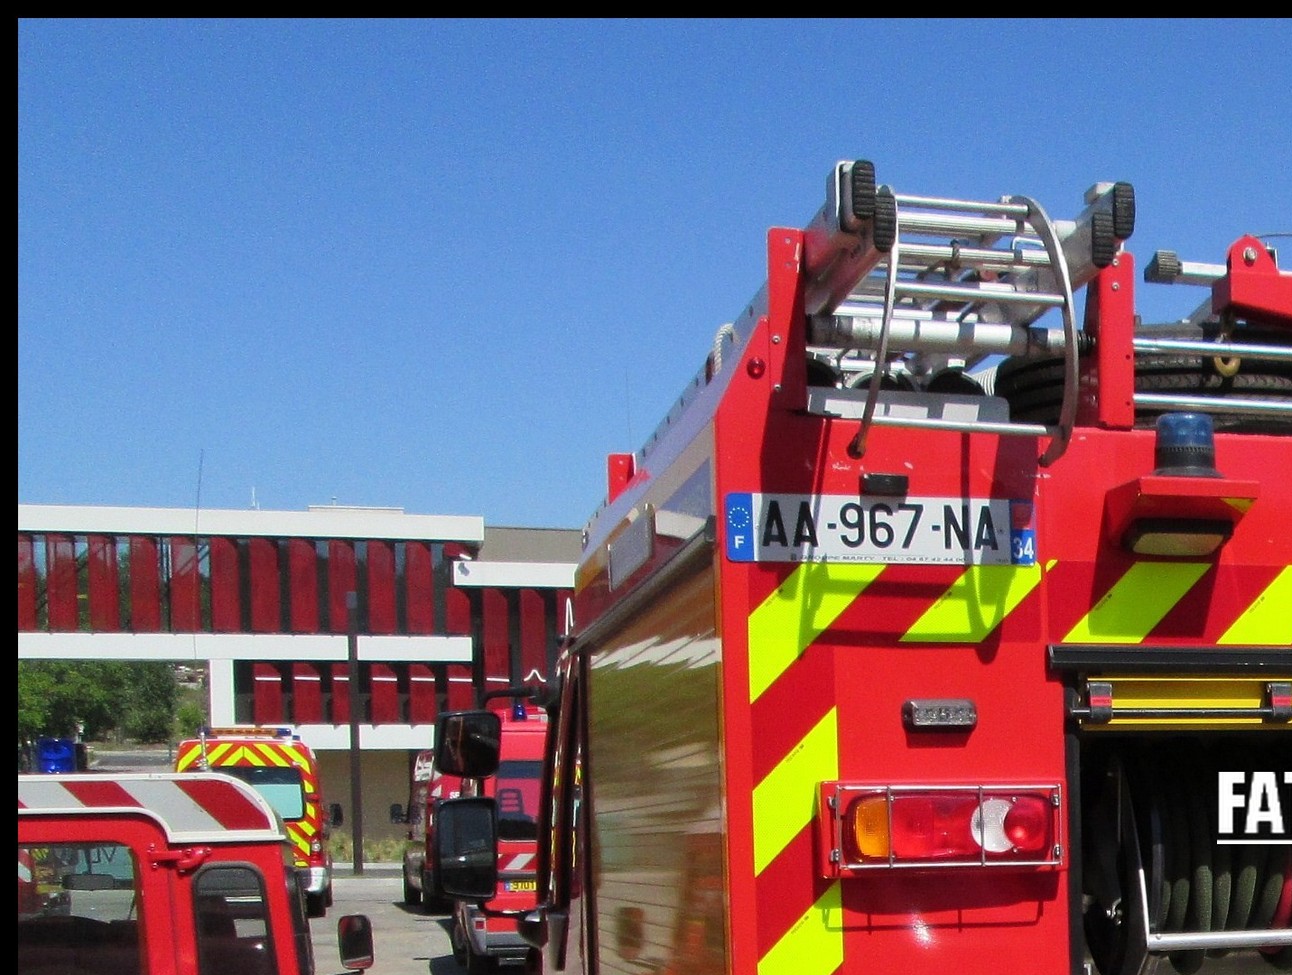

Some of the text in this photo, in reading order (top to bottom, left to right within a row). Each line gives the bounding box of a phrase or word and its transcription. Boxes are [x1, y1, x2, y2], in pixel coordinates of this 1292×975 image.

[762, 499, 999, 551] AA-967-NA
[734, 535, 745, 549] F
[1013, 537, 1035, 559] 34
